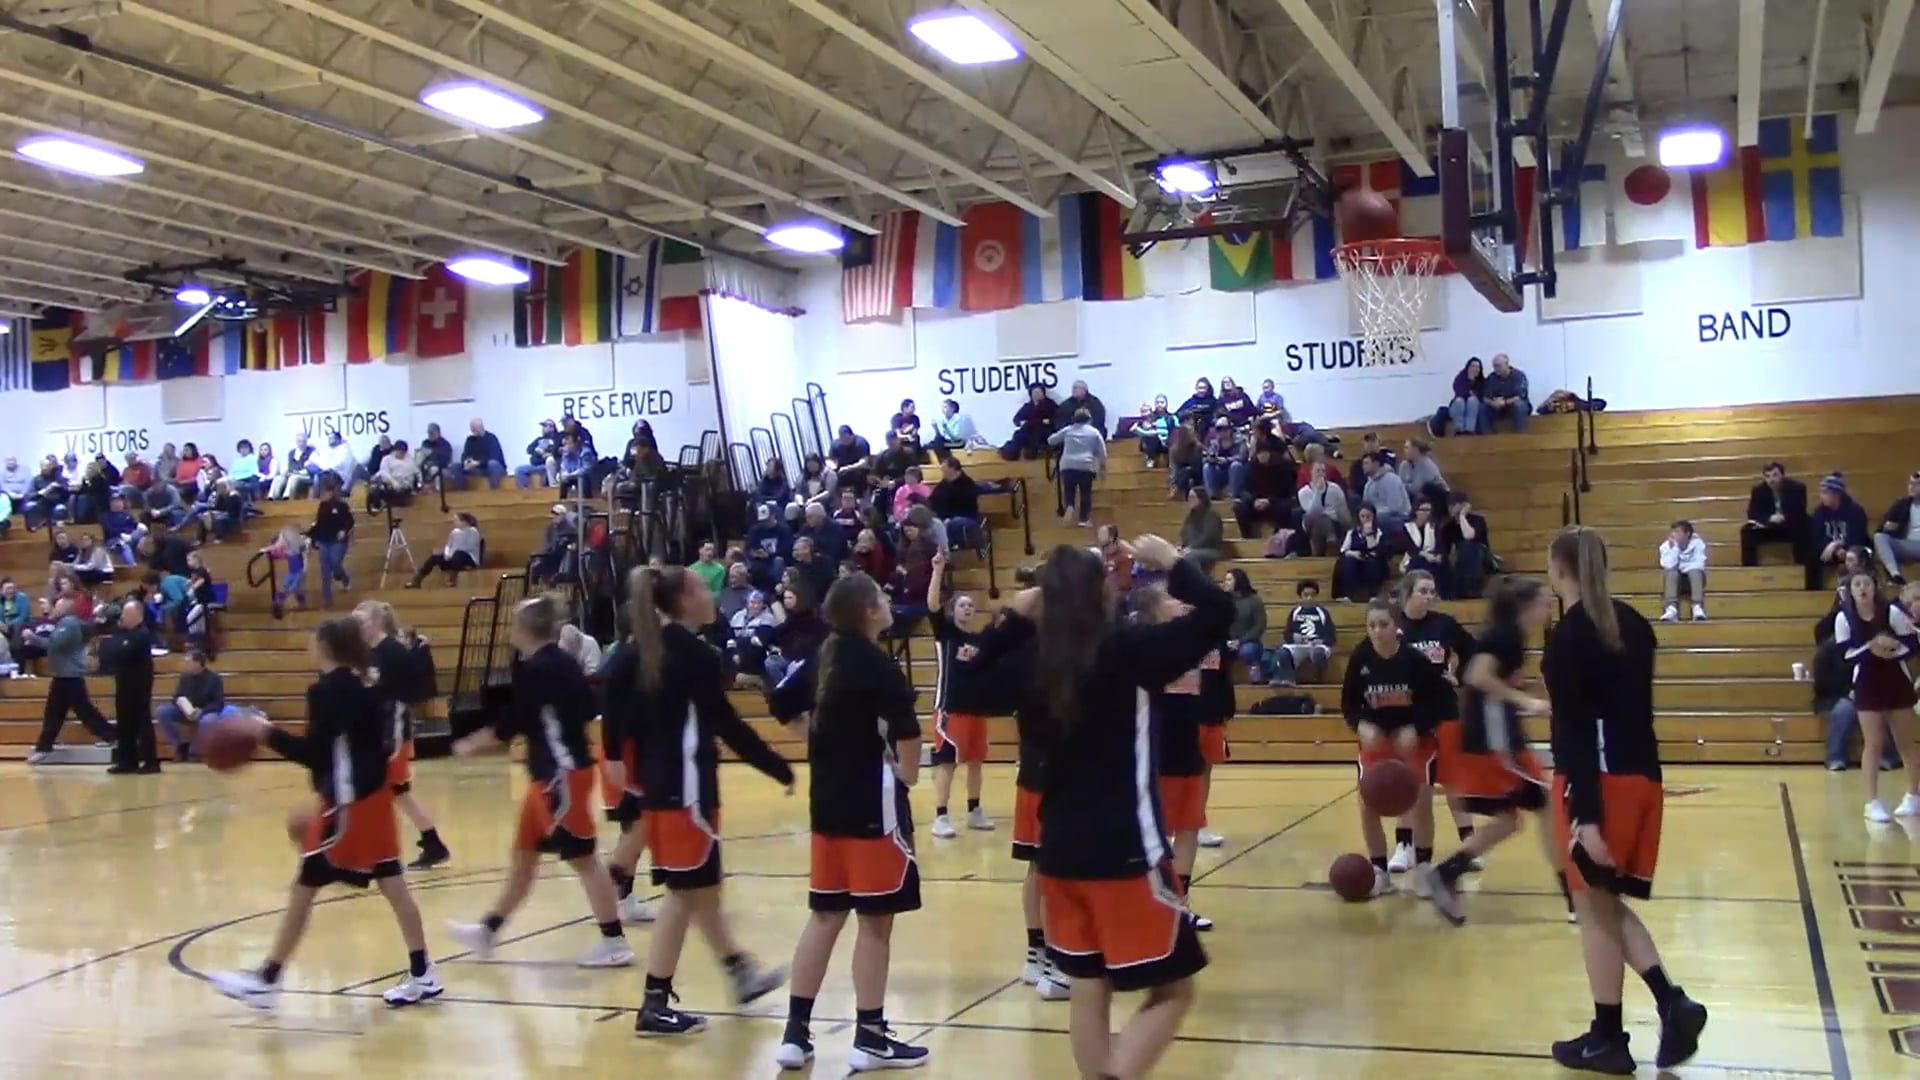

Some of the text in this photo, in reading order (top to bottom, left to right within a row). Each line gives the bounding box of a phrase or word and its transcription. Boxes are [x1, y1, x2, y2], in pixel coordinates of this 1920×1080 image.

[1698, 308, 1791, 342] BAND
[938, 362, 1058, 395] STUDENTS
[563, 390, 673, 420] RESERVED
[302, 410, 390, 439] VISITORS
[65, 427, 149, 455] VISITORS
